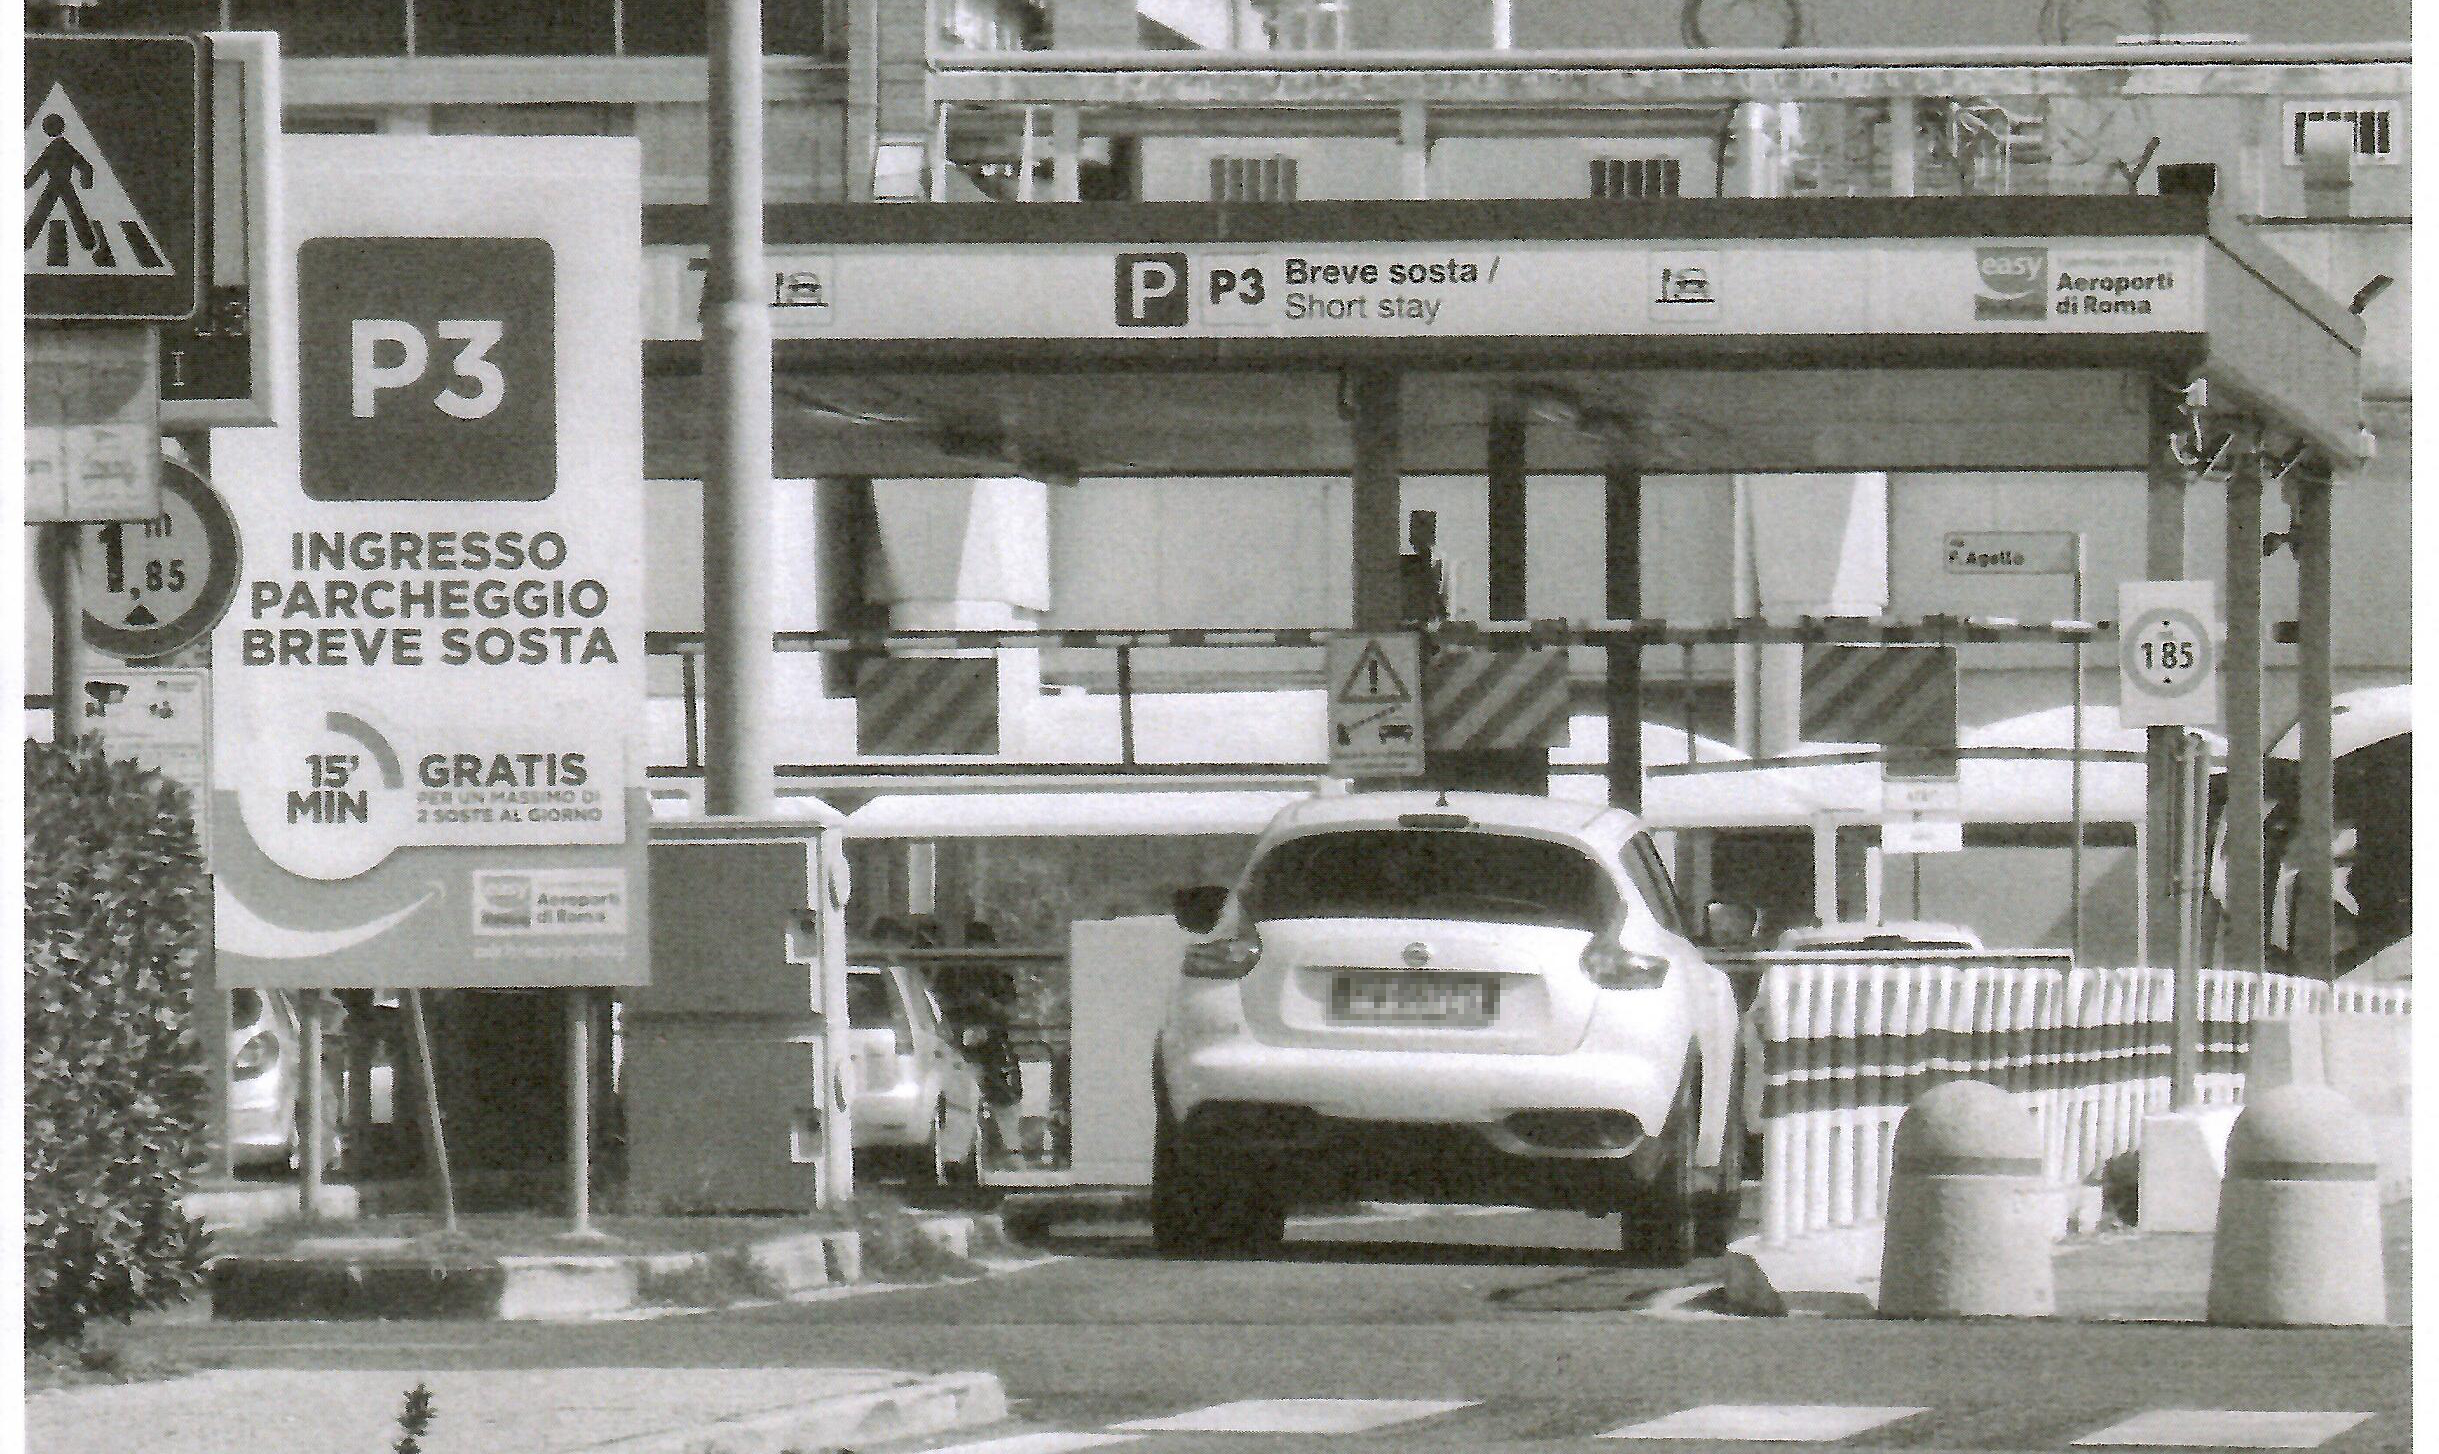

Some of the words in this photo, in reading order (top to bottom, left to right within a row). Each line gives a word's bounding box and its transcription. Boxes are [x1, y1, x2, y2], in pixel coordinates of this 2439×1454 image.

[1284, 258, 1379, 285] Breve
[1388, 258, 1479, 285] sosta
[1981, 255, 2043, 282] easy
[2056, 271, 2174, 296] Aeroporti
[1132, 260, 1177, 320] P
[1209, 267, 1266, 306] P3
[1284, 292, 1369, 320] Short
[1377, 294, 1442, 327] stay
[2056, 295, 2079, 316] di
[2083, 295, 2153, 316] Roma
[350, 317, 506, 420] P3
[292, 531, 568, 571] INGRESSO
[251, 579, 609, 619] PARCHEGGIO
[242, 628, 423, 666] BREVE
[440, 627, 619, 666] SOSTA
[418, 753, 588, 787] GRATIS
[287, 789, 368, 824] MIN
[417, 790, 453, 805] PER
[417, 808, 429, 823] 2
[432, 808, 494, 823] SOSTE
[499, 808, 523, 823] AL
[527, 807, 603, 823] GIORNO
